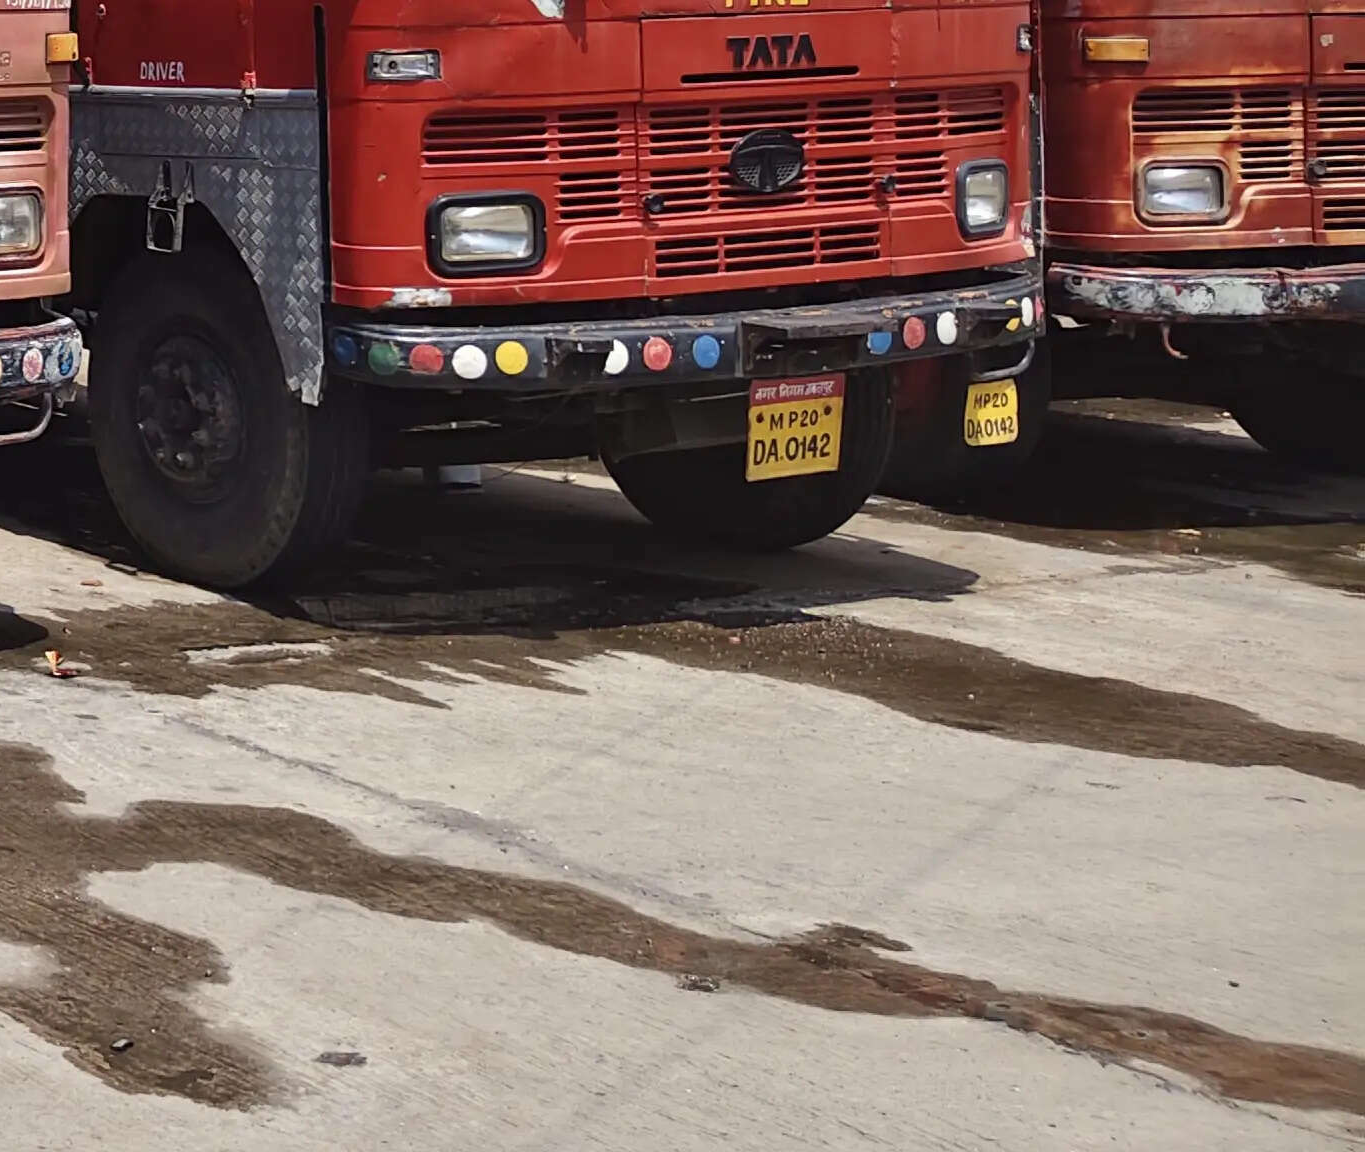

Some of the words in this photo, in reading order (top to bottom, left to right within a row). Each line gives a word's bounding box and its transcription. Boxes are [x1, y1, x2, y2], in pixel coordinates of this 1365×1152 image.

[726, 33, 816, 70] TATA
[140, 61, 185, 82] DRIVER
[973, 392, 1009, 409] MP20
[967, 415, 1014, 439] DA0142
